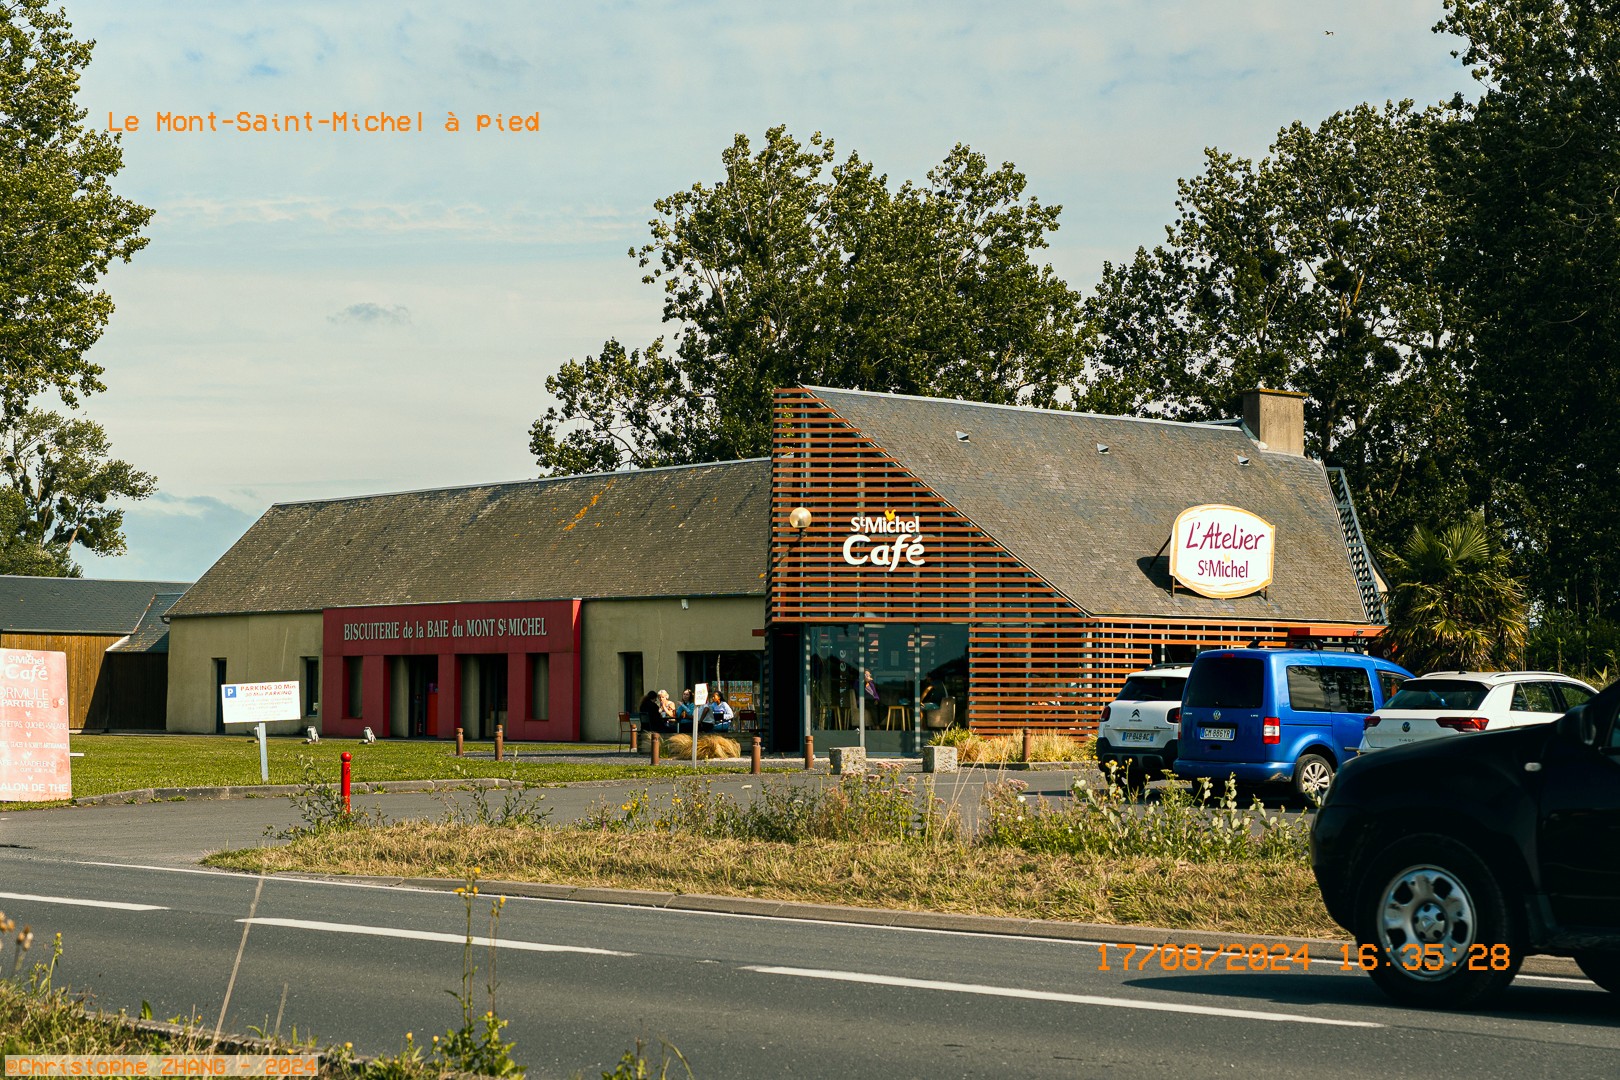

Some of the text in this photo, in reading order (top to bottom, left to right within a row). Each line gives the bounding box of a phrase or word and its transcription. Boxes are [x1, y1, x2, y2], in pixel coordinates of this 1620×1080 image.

[1186, 521, 1265, 550] L'Atelier
[843, 534, 926, 572] Café
[344, 622, 400, 641] BISCUITERIE
[402, 621, 414, 639] de
[415, 620, 425, 638] la
[427, 620, 449, 638] BAIE
[452, 619, 463, 637] du
[466, 619, 496, 637] MONT
[508, 617, 547, 636] MICHEL
[5, 663, 48, 683] Café
[0, 686, 49, 700] ORMULE
[240, 684, 273, 692] PARKING
[36, 700, 49, 709] DE
[0, 782, 28, 792] ALON
[31, 783, 45, 792] DE
